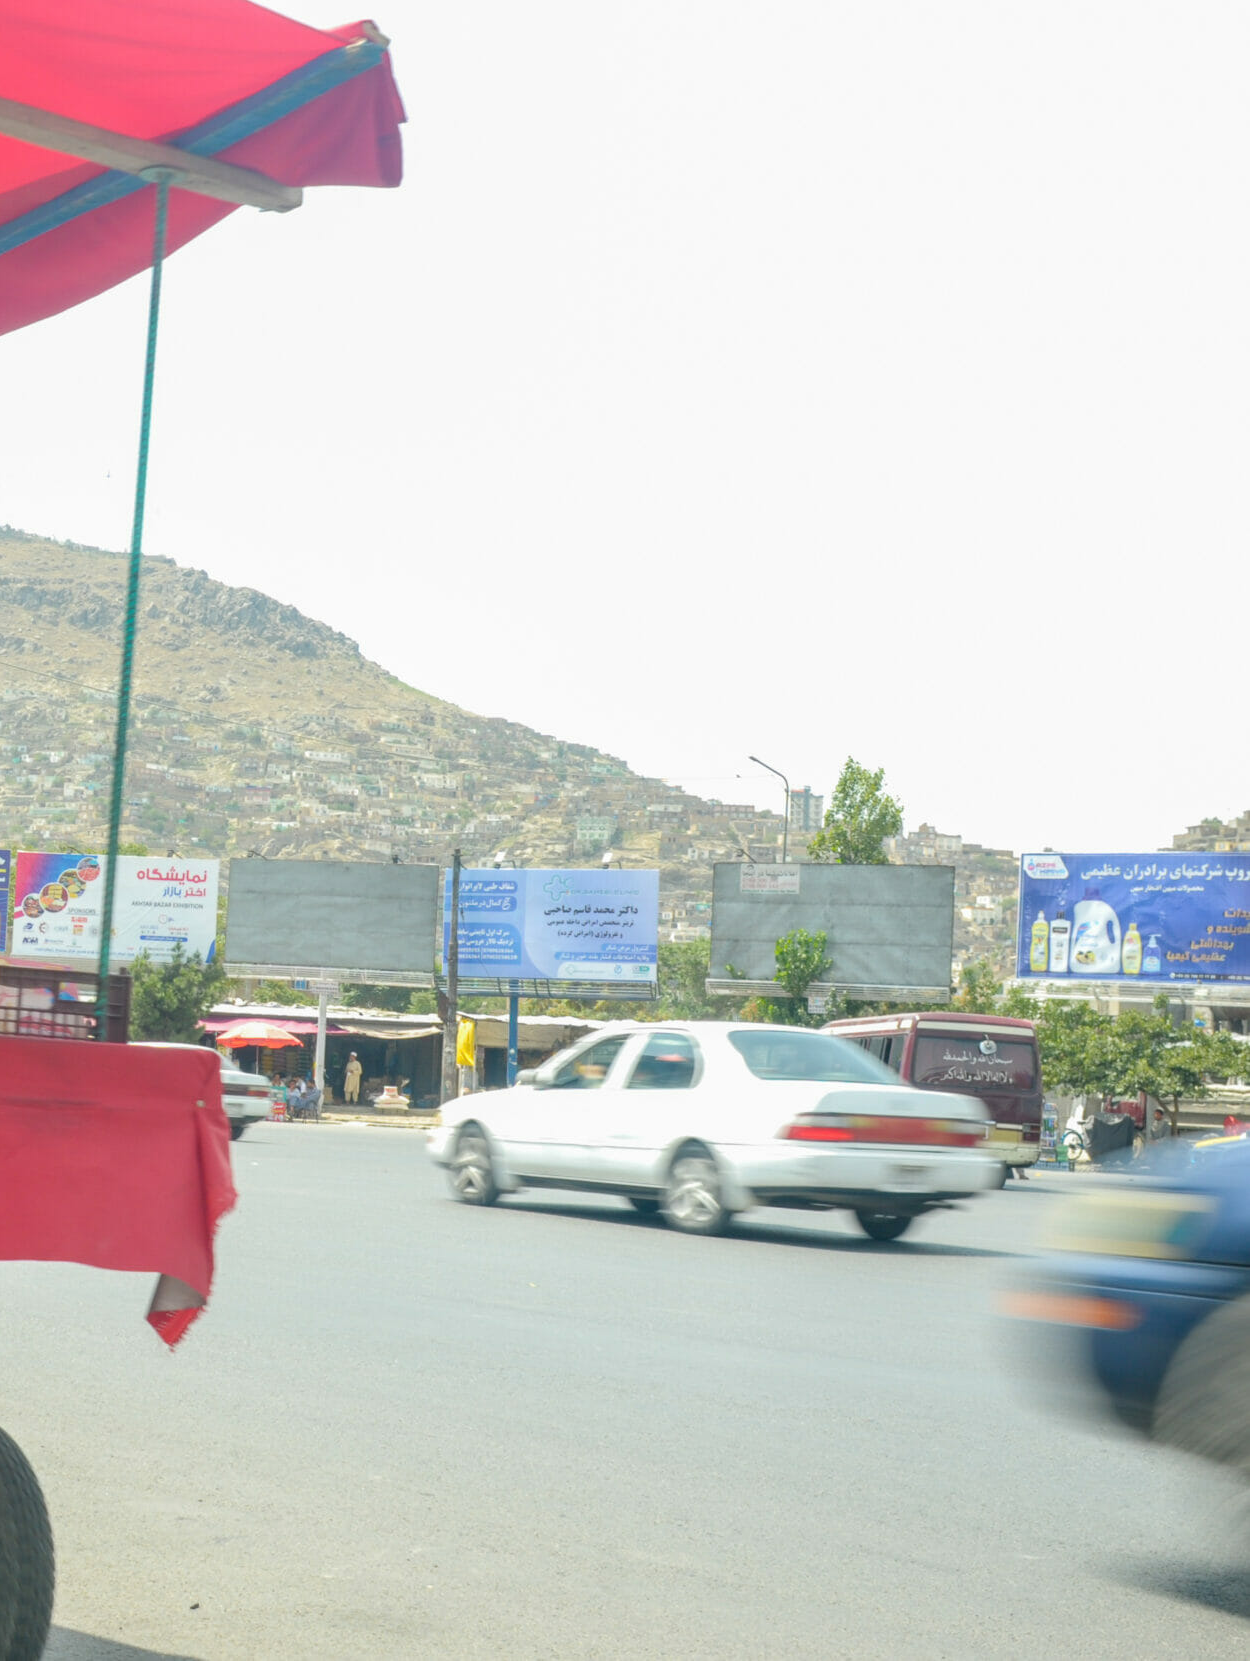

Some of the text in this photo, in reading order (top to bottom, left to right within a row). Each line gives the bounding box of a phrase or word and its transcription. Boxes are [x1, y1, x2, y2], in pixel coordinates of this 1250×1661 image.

[136, 866, 208, 885] نمایشگاه
[1080, 862, 1250, 882] روپ شرکتهای برادران عظیمی
[162, 887, 206, 899] اختر بازار
[543, 904, 639, 917] داکتر محمد قاسم صاحبی
